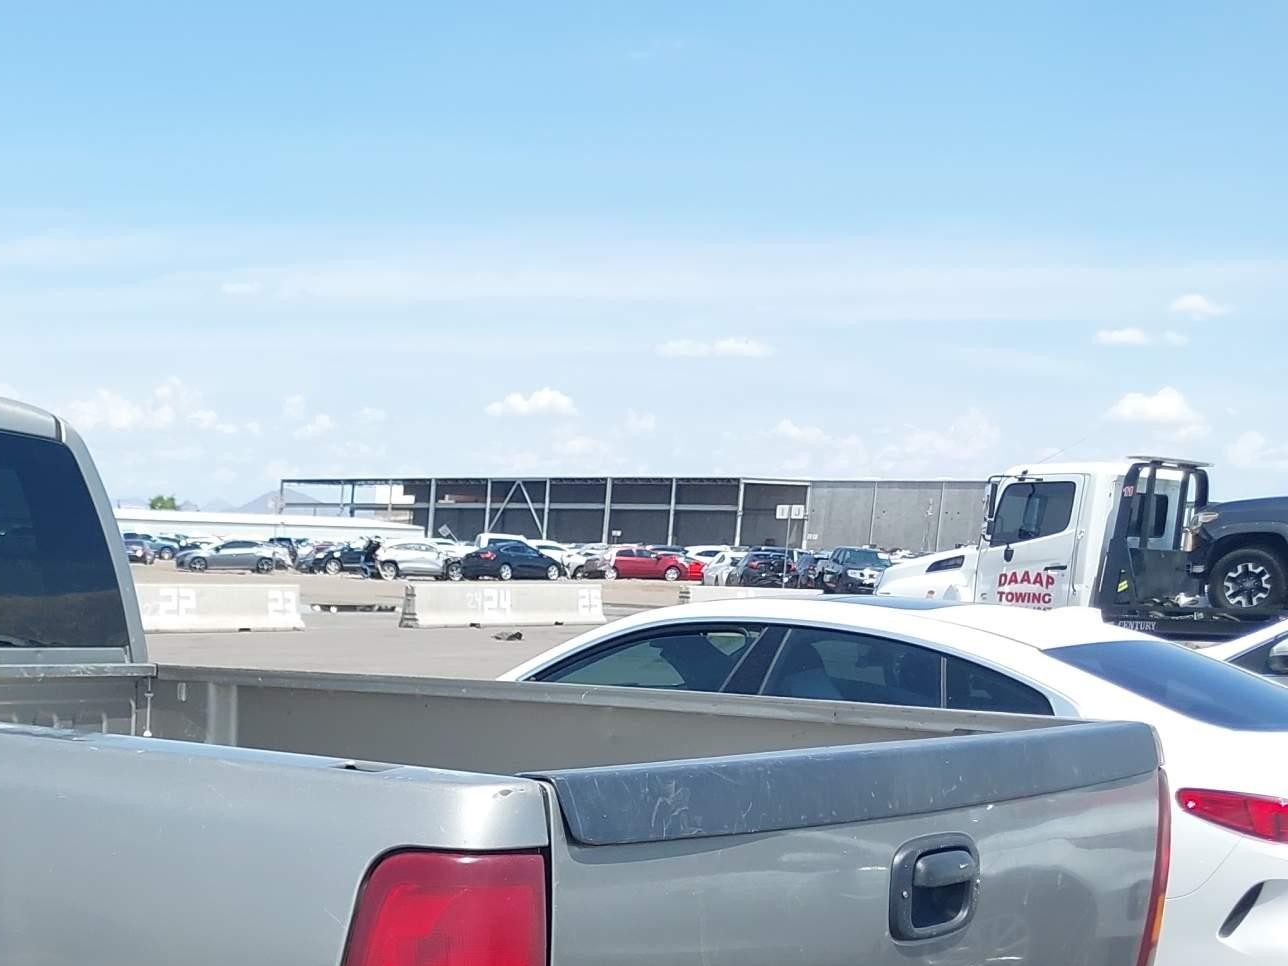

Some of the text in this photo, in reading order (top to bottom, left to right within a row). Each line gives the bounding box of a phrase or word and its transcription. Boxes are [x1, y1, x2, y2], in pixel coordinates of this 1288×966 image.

[998, 571, 1056, 589] DAAAP
[159, 589, 196, 616] 22
[268, 590, 296, 617] 23
[483, 588, 511, 616] 24
[997, 591, 1053, 605] TOWING
[1118, 621, 1156, 631] CENTURY
